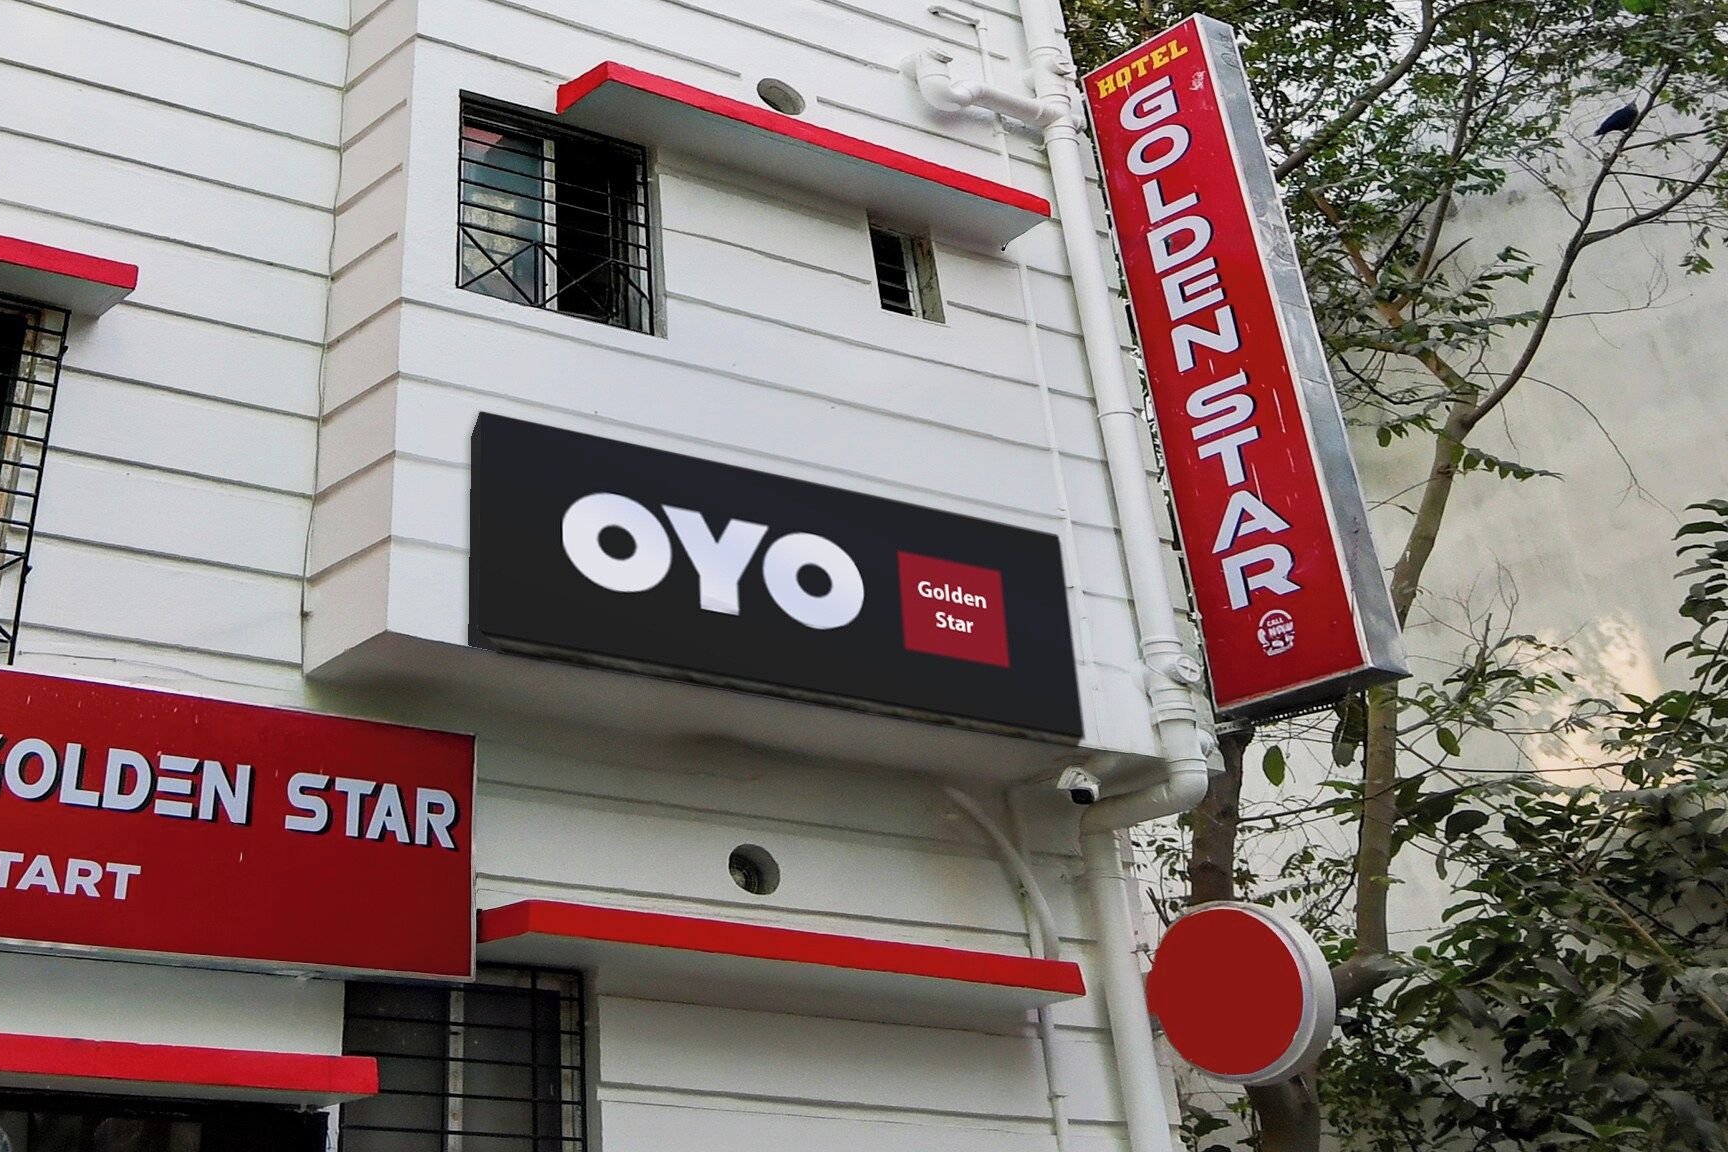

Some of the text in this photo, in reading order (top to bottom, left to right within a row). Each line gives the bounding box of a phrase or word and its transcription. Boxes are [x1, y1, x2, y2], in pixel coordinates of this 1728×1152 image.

[1095, 39, 1189, 99] HOTEL
[1119, 75, 1301, 611] GOLDEN STAR
[562, 492, 864, 630] OYO
[917, 580, 987, 609] Golden
[935, 611, 974, 634] Star
[285, 772, 459, 850] STAR
